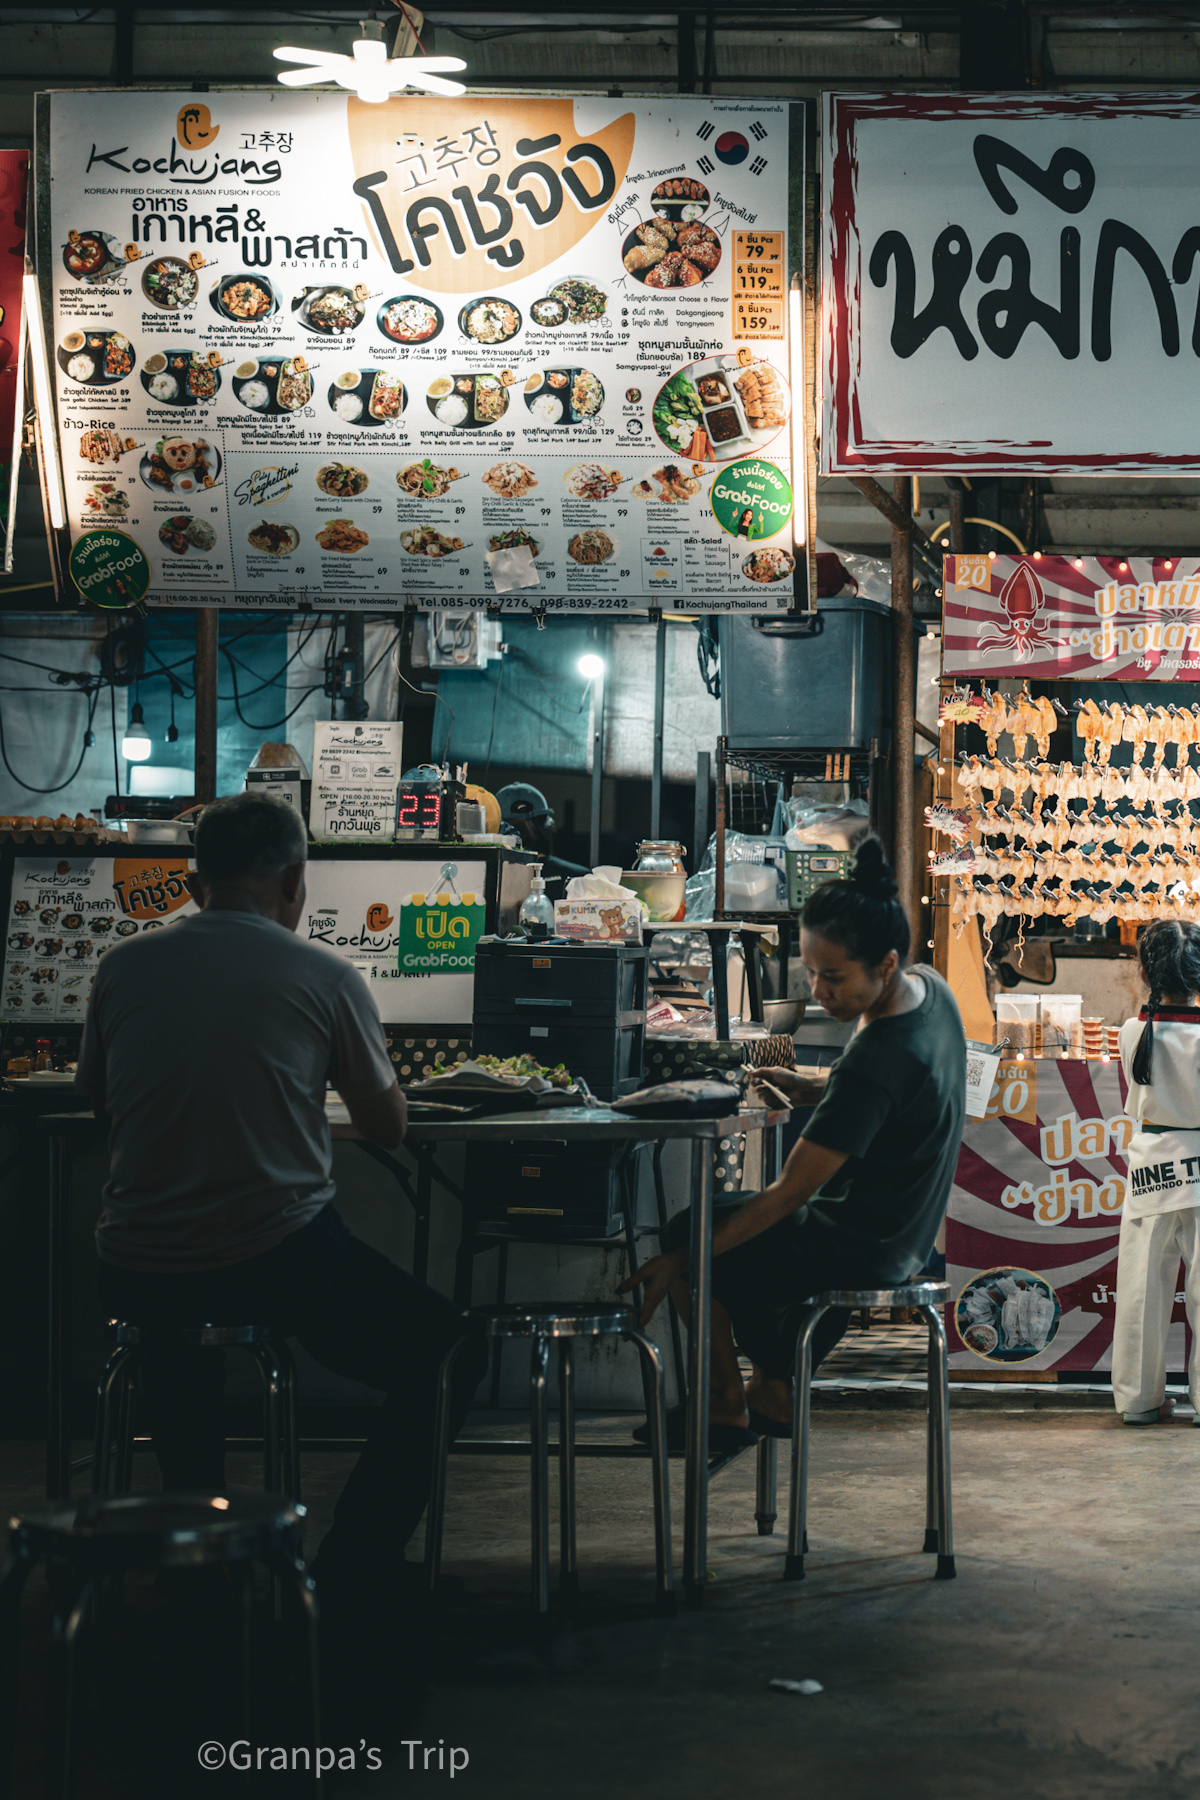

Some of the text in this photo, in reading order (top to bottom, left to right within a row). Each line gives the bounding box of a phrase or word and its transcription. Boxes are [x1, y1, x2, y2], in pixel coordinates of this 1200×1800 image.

[239, 131, 293, 153] 고추장
[86, 137, 281, 184] Kochujang
[395, 120, 501, 192] 고추장
[132, 198, 187, 212] อาหาร
[353, 133, 616, 274] โคชูจัง
[132, 203, 265, 242] เกาหลี &
[747, 233, 758, 243] ชิ้น
[242, 227, 368, 267] พาสต้า
[746, 245, 763, 258] 79
[747, 263, 758, 274] ชิ้น
[741, 276, 766, 288] 119
[676, 309, 724, 317] Dakgangjeong
[748, 302, 759, 313] ชิ้น
[632, 319, 714, 328] โคชูจัง Yangnyeom
[741, 317, 767, 329] 159
[638, 336, 723, 351] ชุดหมูสามชั้นผักห่อ
[687, 351, 706, 360] 189
[616, 363, 671, 371] Samgyupsal-gui
[63, 417, 115, 429] ข้าว-Rice
[732, 463, 783, 490] ร้านนี้อร่อย
[714, 485, 791, 515] GrabFood
[541, 508, 551, 516] 99
[617, 509, 628, 517] 99
[75, 536, 120, 565] ร้านนี้อร่อย
[960, 556, 986, 565] เริ่มต้น
[78, 549, 143, 589] GrabFood
[956, 566, 987, 586] 20
[234, 595, 296, 606] หยุดทุกวันพุธ
[359, 598, 398, 606] Wednesday
[540, 598, 628, 609] 098-839-2242
[686, 600, 767, 610] KochujangThailand
[1136, 656, 1152, 671] By
[331, 736, 383, 746] Kochujang
[351, 766, 368, 774] Grab
[338, 806, 374, 819] ร้านหยุด
[399, 795, 440, 826] 23
[330, 819, 381, 835] ทุกวันพุธ
[25, 871, 91, 886] Kochujang
[127, 866, 164, 888] 고추장
[38, 892, 75, 905] เกาหลี
[73, 898, 116, 912] พาสต้า
[308, 915, 336, 929] โคชูจัง
[416, 910, 470, 938] เปิด
[427, 941, 456, 949] OPEN
[1131, 1161, 1176, 1189] NINE
[1132, 1180, 1183, 1197] TAEKWONDO
